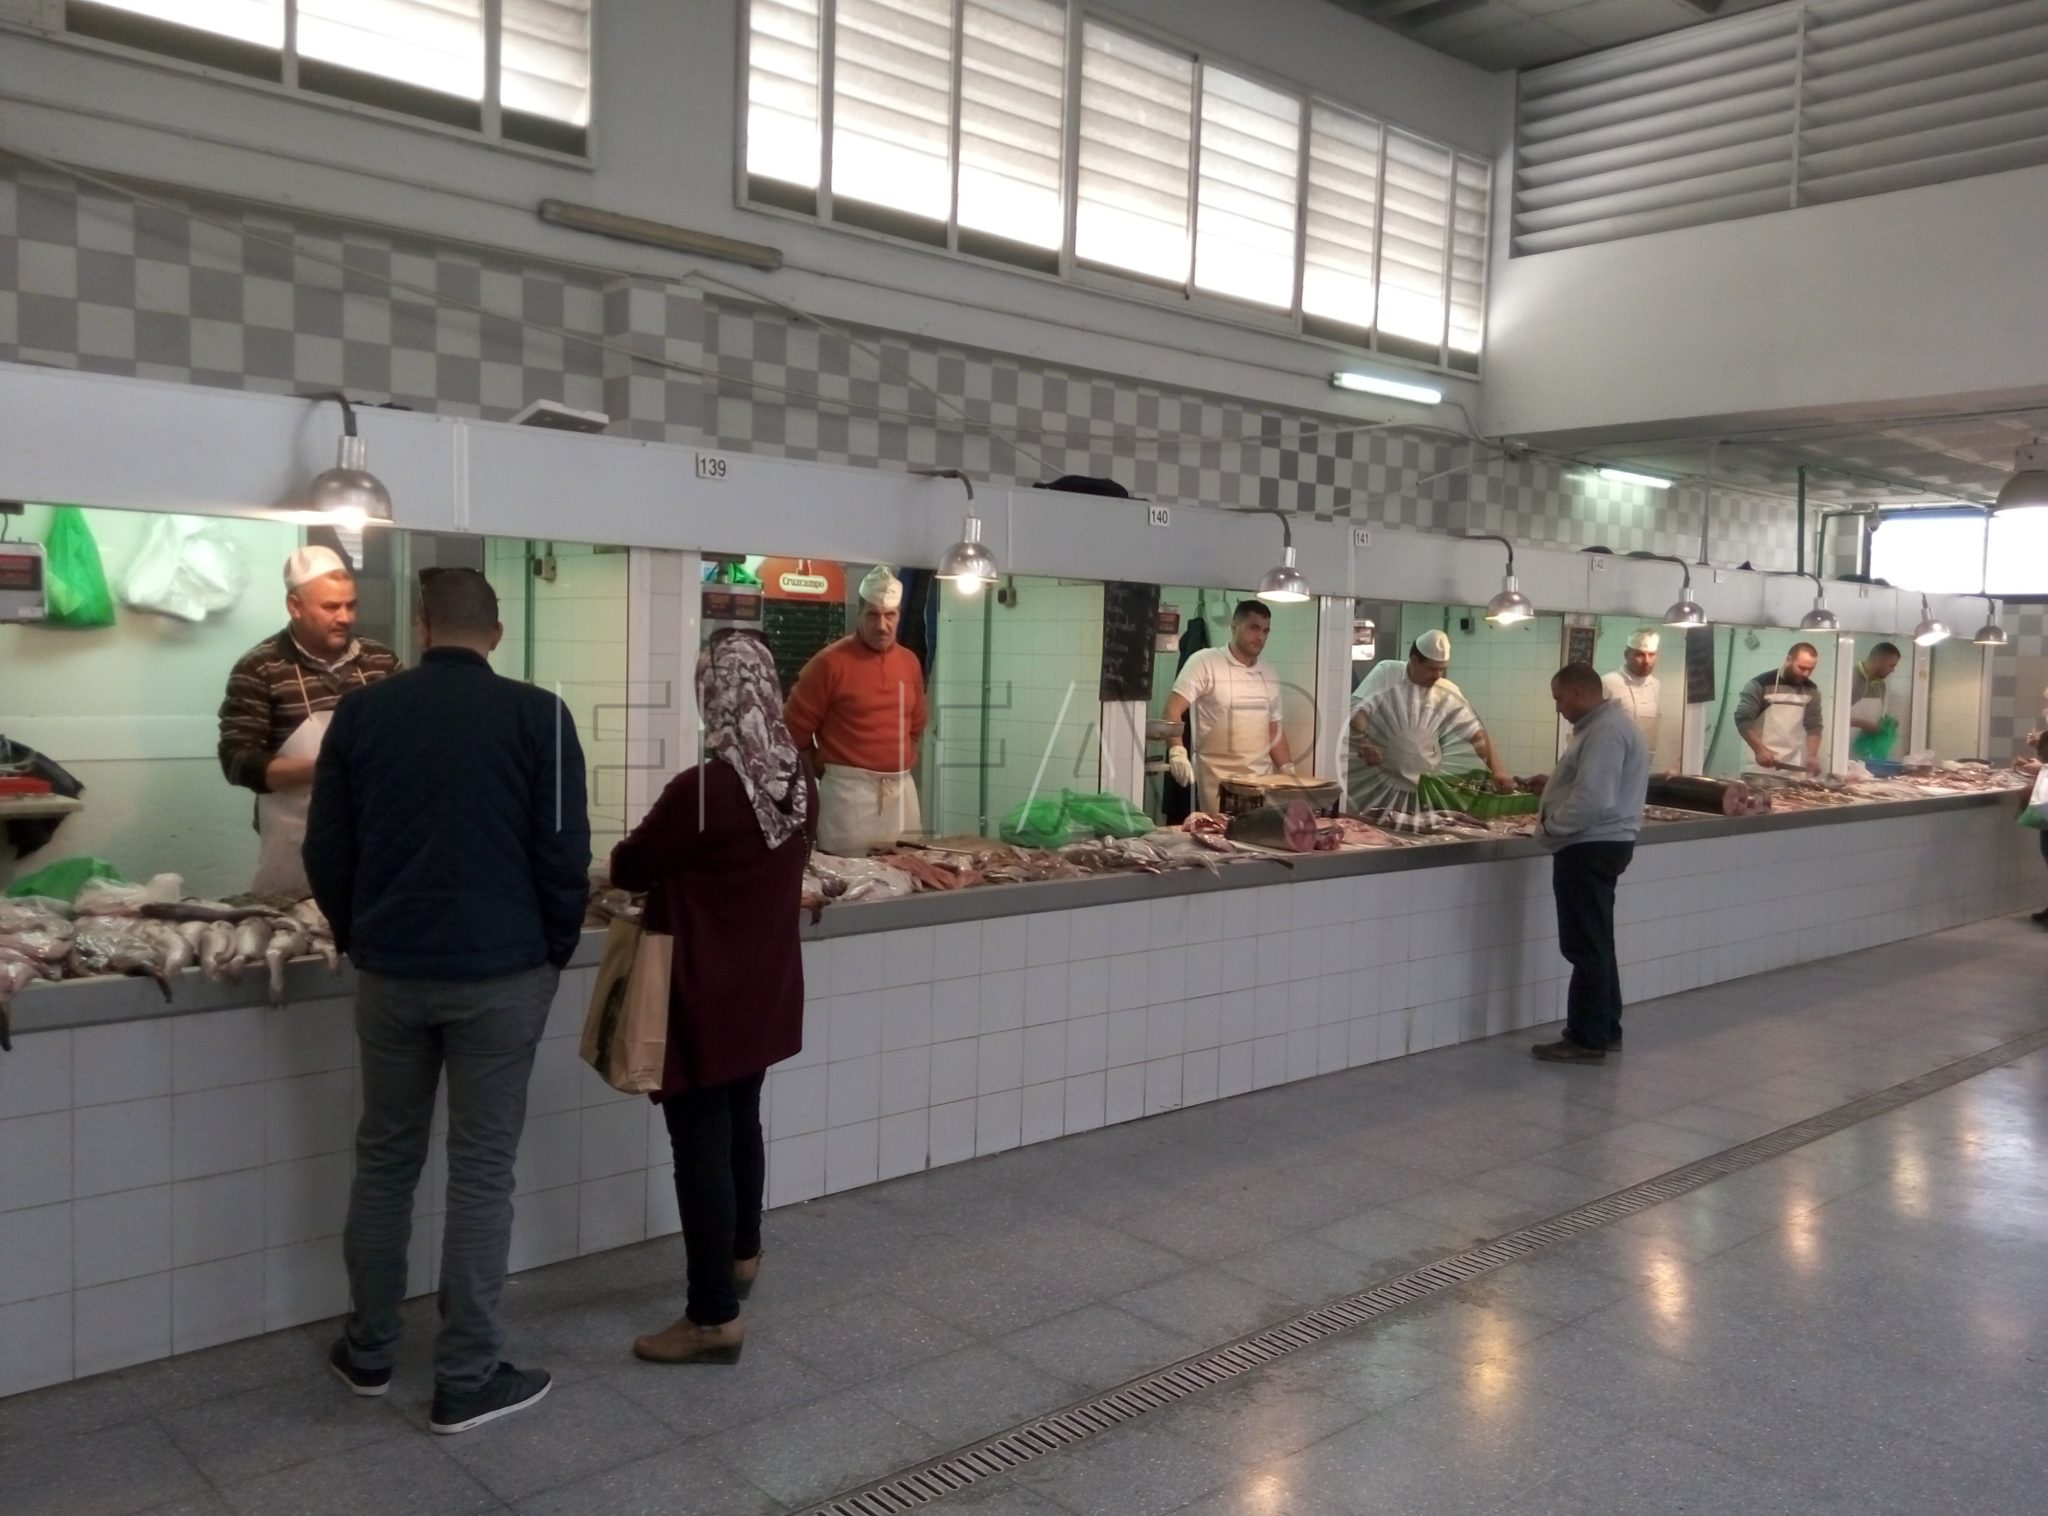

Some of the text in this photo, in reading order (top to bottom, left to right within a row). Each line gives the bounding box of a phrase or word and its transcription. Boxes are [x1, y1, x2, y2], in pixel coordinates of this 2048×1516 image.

[700, 457, 726, 477] 139
[1152, 509, 1168, 524] 140
[1356, 533, 1369, 544] 141
[782, 576, 825, 589] Cruzcampo
